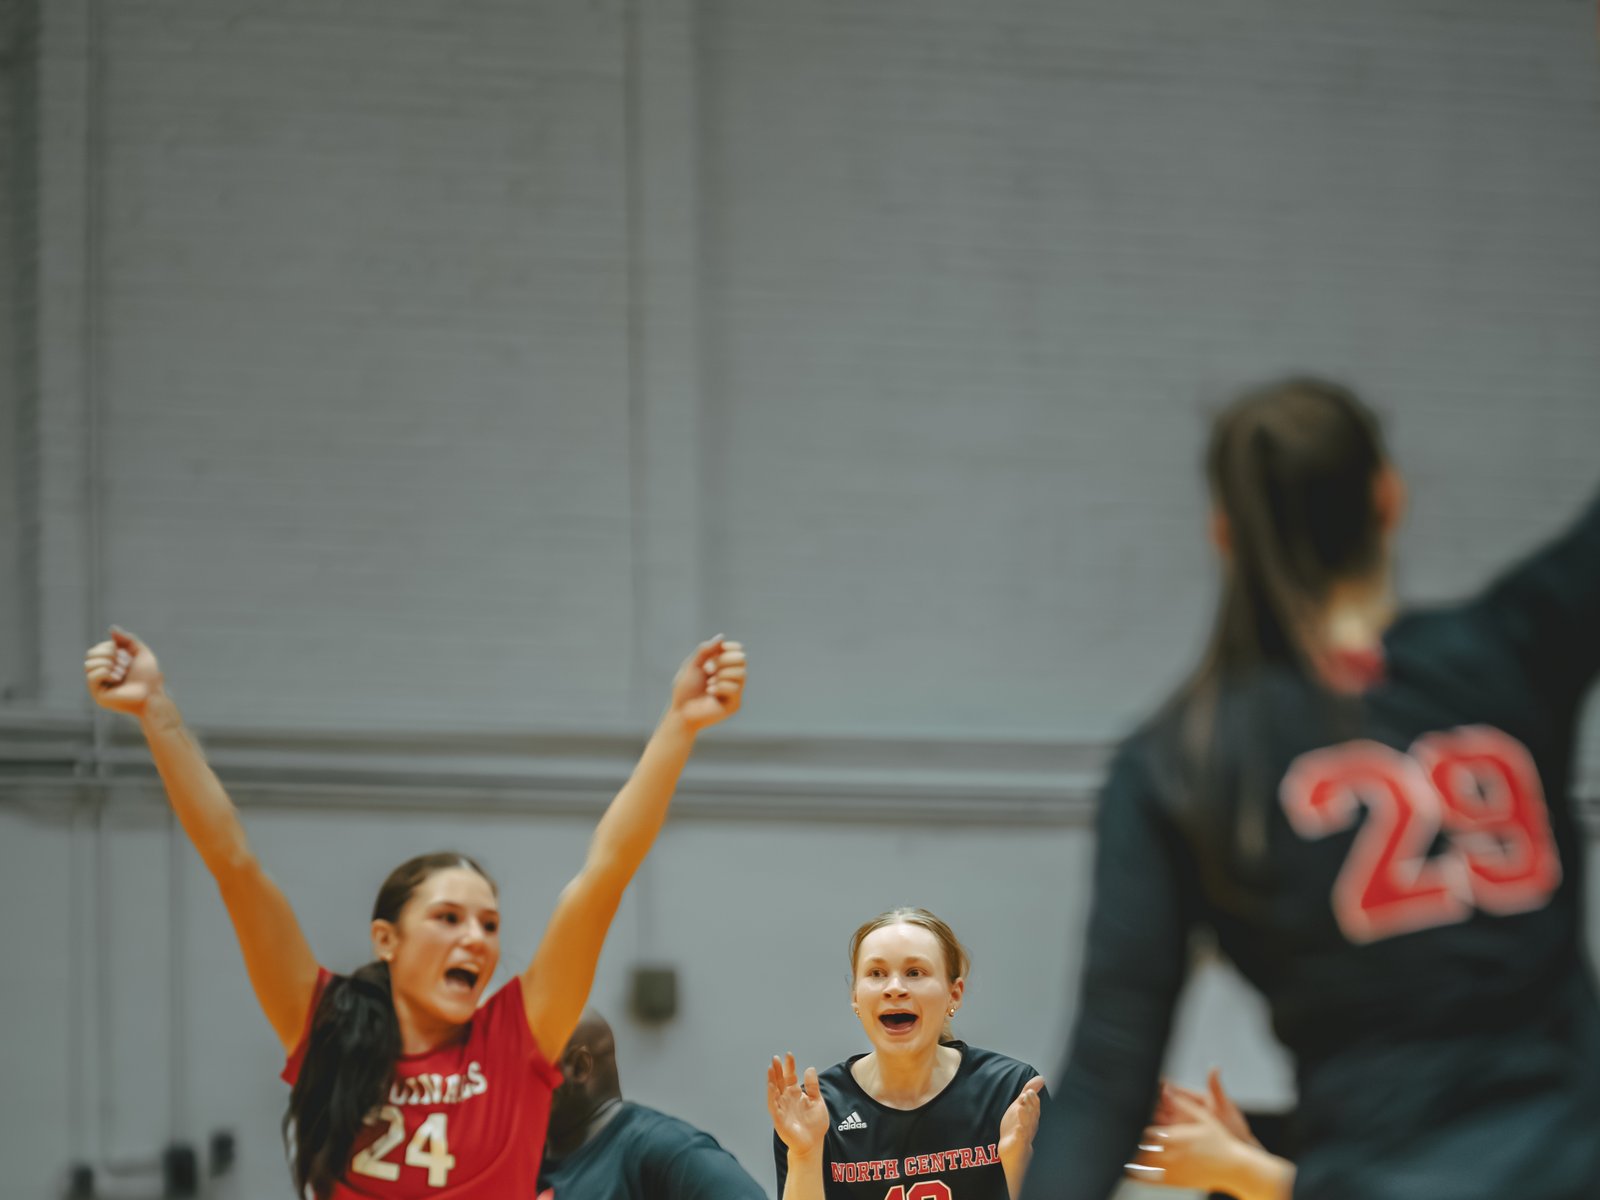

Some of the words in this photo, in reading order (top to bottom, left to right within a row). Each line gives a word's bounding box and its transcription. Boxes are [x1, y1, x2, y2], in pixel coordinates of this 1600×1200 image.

[1280, 724, 1562, 945] 29
[352, 1105, 455, 1188] 24
[837, 1121, 867, 1132] adidas
[831, 1159, 900, 1182] NORTH
[904, 1143, 1001, 1176] CENTRAL
